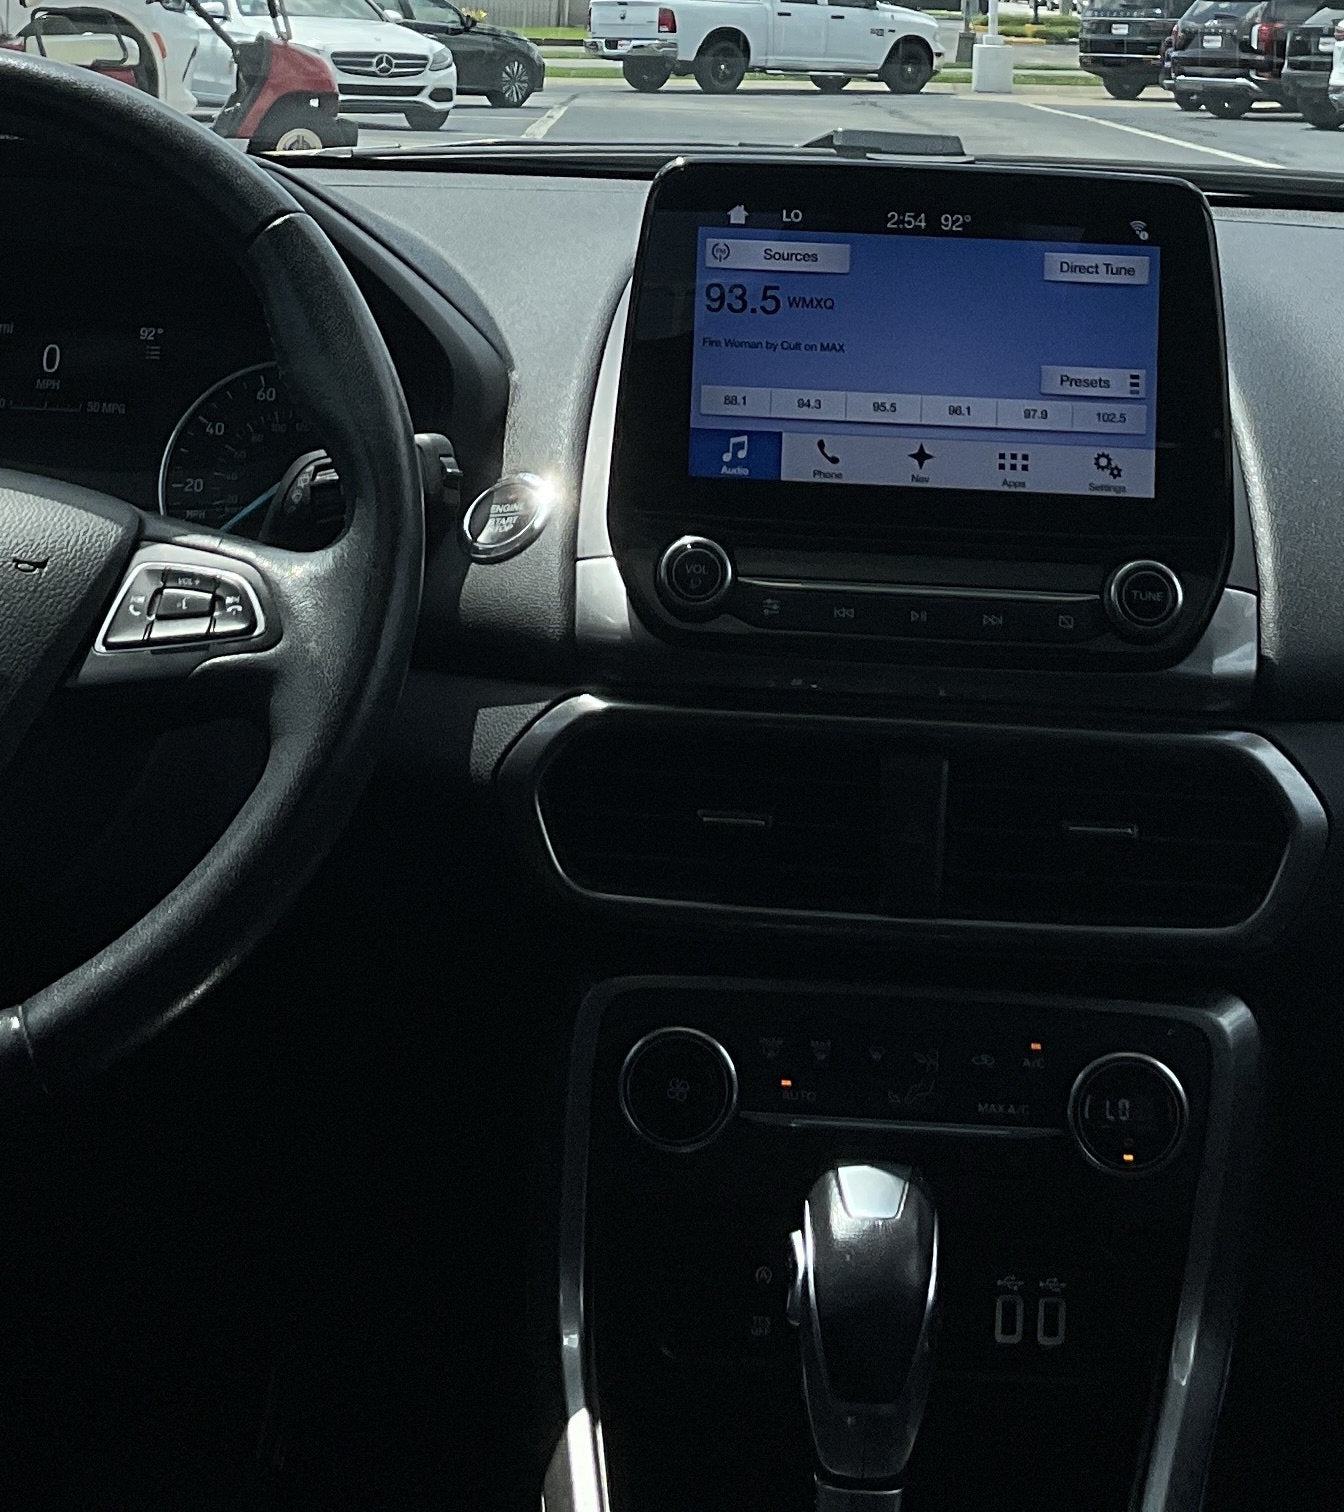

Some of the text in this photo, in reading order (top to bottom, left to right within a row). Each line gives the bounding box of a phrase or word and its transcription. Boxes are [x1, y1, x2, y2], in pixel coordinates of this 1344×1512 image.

[782, 209, 803, 223] LO
[887, 211, 927, 230] 2:54
[763, 248, 819, 264] Sources
[1059, 261, 1136, 276] Direct Tune
[704, 282, 836, 316] 93.5 WMXQ
[724, 338, 764, 349] Woman
[765, 340, 778, 353] by
[803, 342, 818, 352] on
[820, 342, 846, 354] MAX
[43, 343, 61, 373] 0
[1059, 374, 1111, 389] Presets
[255, 387, 277, 401] 60
[797, 398, 822, 410] 94.3
[872, 401, 897, 413] 95.5
[1096, 412, 1127, 424] 102.5
[205, 421, 225, 435] 40
[183, 478, 204, 493] 20
[721, 464, 1127, 495] Audio Phone Nav Apps Settings
[685, 564, 709, 576] VOL
[1131, 591, 1165, 603] TUNE
